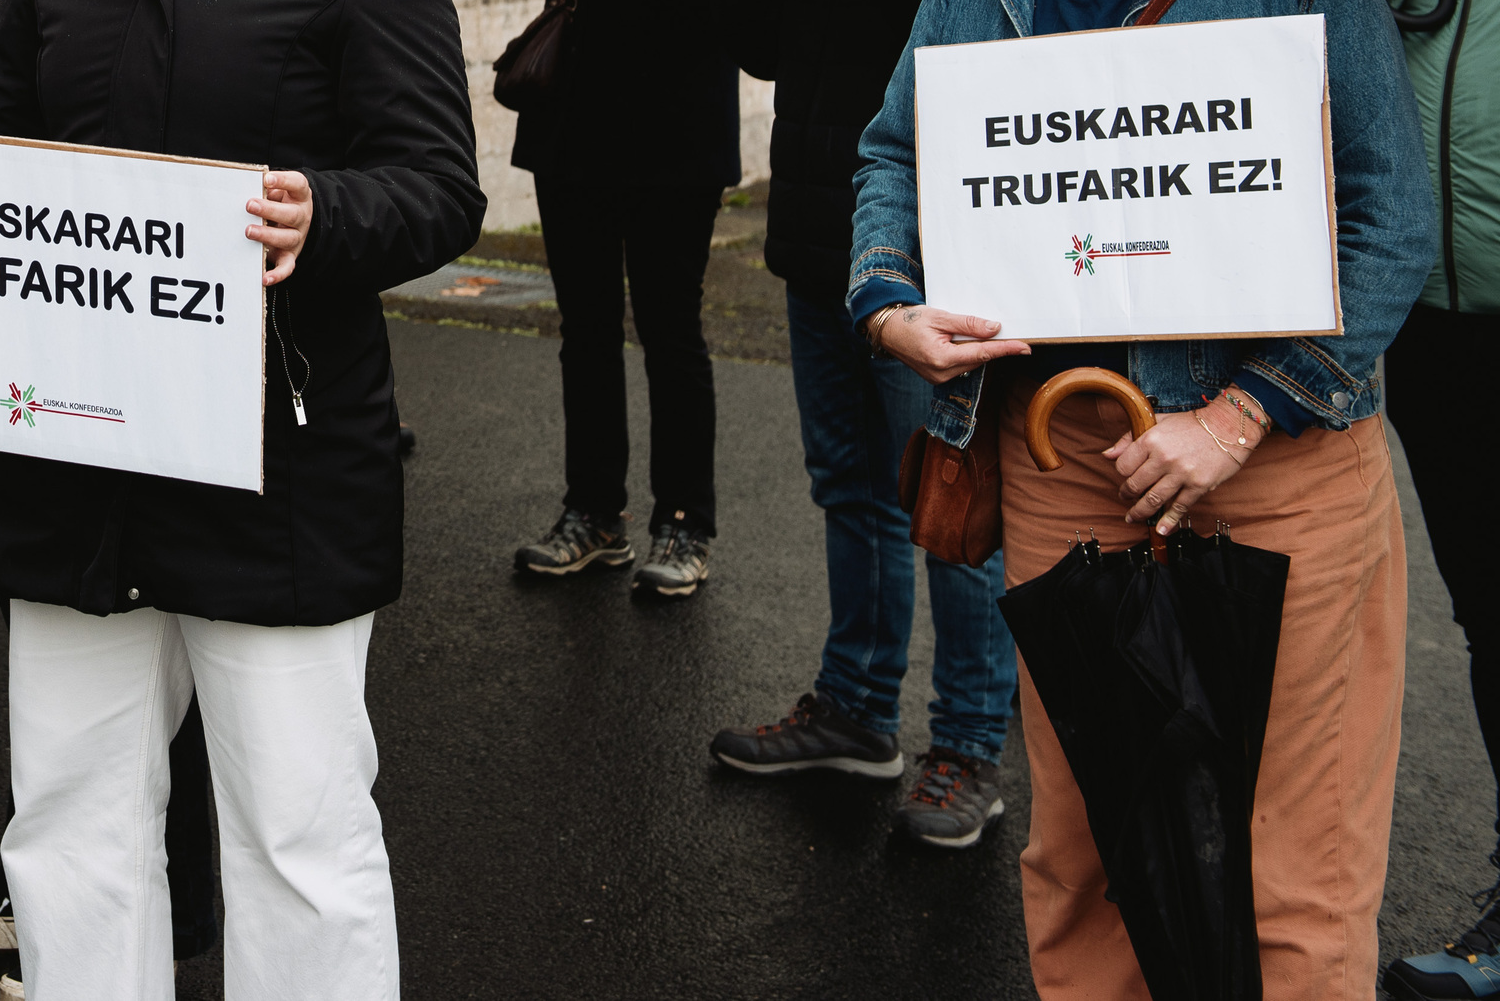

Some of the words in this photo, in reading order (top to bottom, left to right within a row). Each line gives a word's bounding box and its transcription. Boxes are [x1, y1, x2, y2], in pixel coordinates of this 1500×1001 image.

[985, 97, 1253, 148] EUSKARARI
[962, 163, 1192, 208] TRUFARIK
[1208, 158, 1283, 195] EZ!
[1102, 242, 1125, 253] EUSKAL
[1125, 239, 1170, 252] KONFEDERAZIOA
[150, 276, 225, 325] EZ!
[42, 398, 68, 409] EUSKAL
[69, 402, 123, 417] KONFEDERAZIOA
